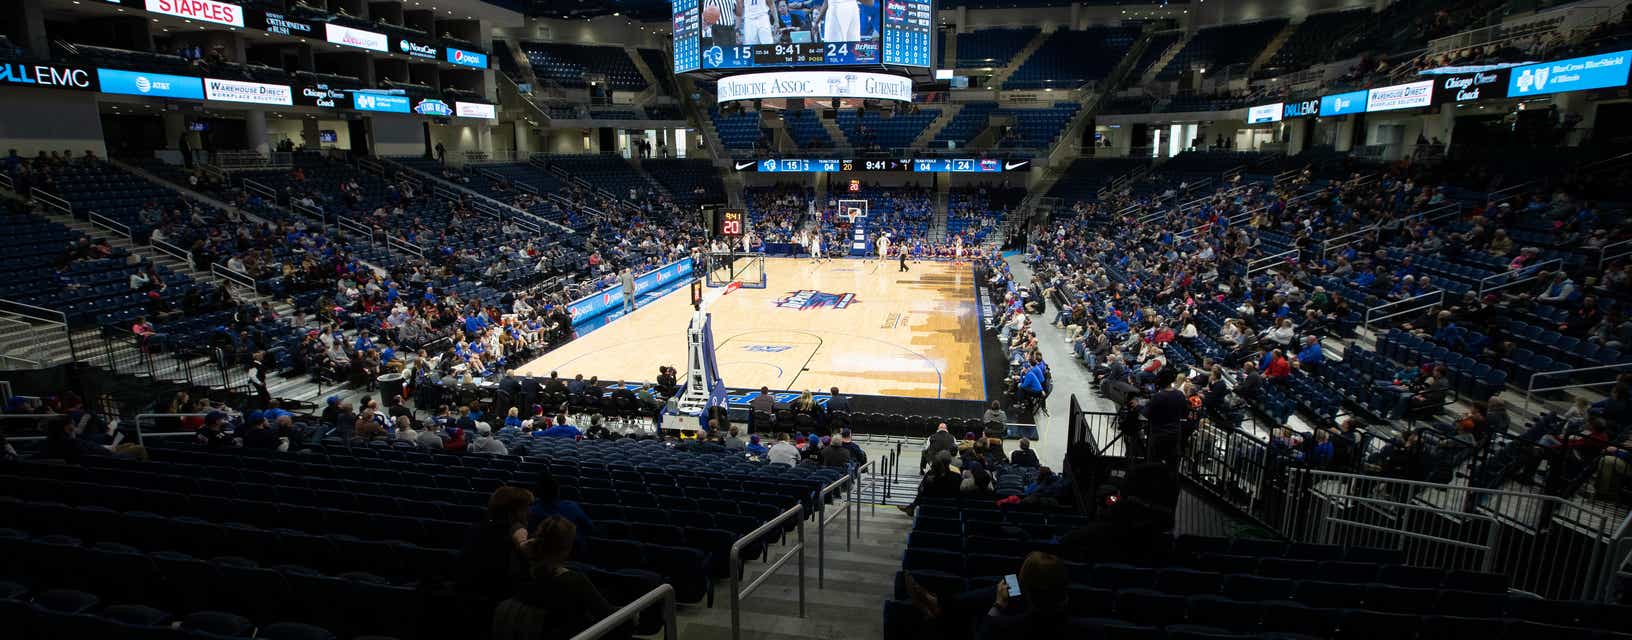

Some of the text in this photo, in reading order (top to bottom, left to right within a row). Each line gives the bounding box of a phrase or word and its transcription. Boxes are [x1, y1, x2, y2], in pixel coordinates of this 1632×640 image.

[160, 0, 234, 22] STAPLES
[733, 47, 751, 59] 15
[775, 45, 800, 55] 9:41
[827, 44, 849, 57] 24
[35, 66, 89, 88] EMC
[211, 82, 285, 96] WAREHOUSE DIRECT
[728, 80, 767, 97] MEDICINE
[771, 79, 813, 94] ASSOC.
[865, 78, 899, 96] GURNEE
[787, 161, 797, 170] 15
[804, 163, 809, 171] 3
[824, 163, 834, 171] 04
[866, 161, 886, 170] 9:41
[920, 163, 931, 171] 04
[958, 161, 969, 170] 24
[850, 183, 859, 191] 20
[724, 220, 739, 234] 20
